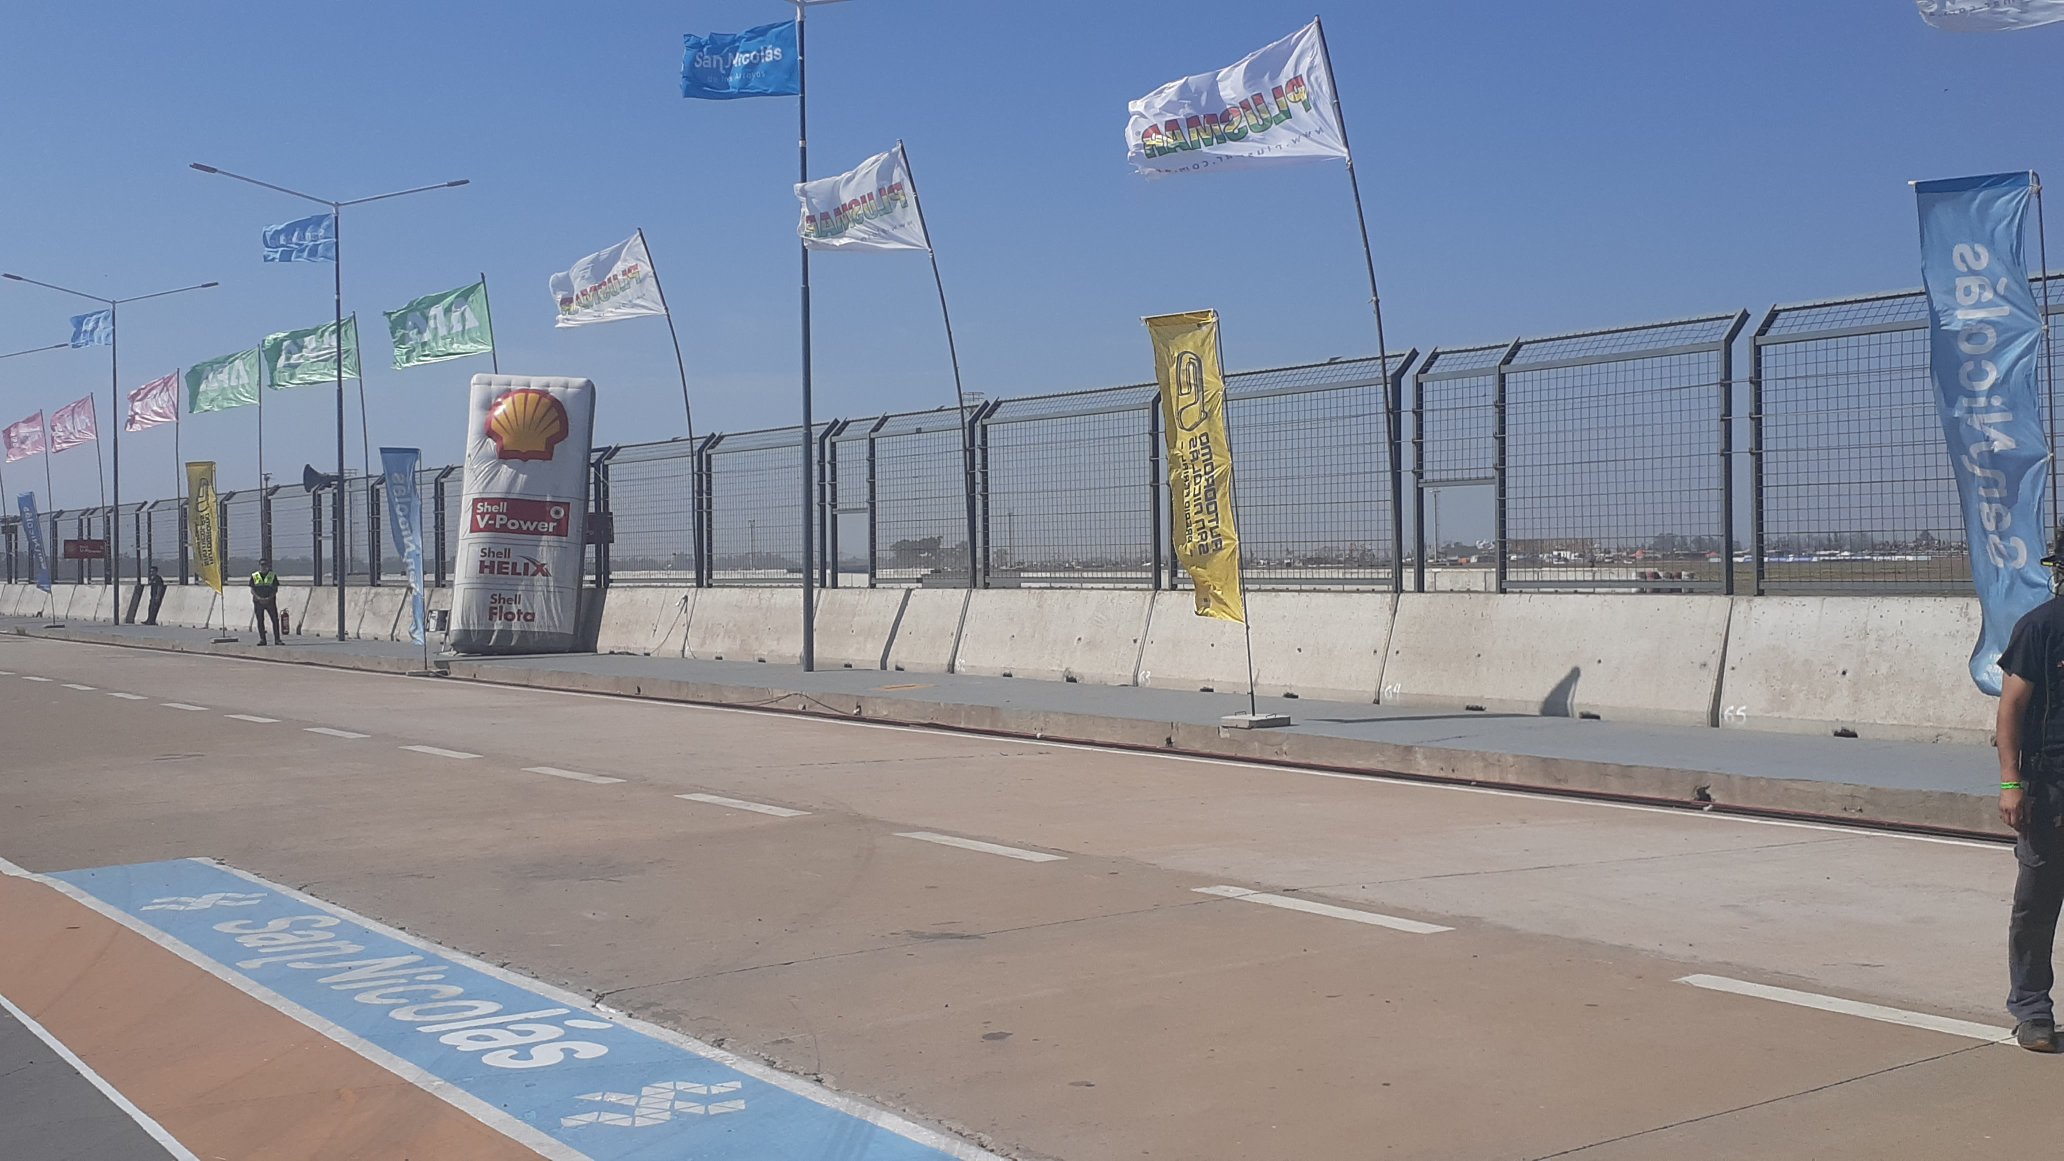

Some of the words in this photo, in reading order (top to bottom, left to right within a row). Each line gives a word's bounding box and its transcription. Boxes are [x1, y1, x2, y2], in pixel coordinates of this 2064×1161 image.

[694, 52, 726, 74] San
[725, 45, 783, 68] Nicolás
[476, 502, 507, 513] Shell
[476, 514, 557, 532] V-Power
[480, 547, 511, 559] Shell
[479, 559, 552, 577] HELIX
[490, 593, 522, 605] Shell
[488, 606, 536, 622] Flota
[212, 914, 366, 969] San
[286, 954, 614, 1069] Nicolás
